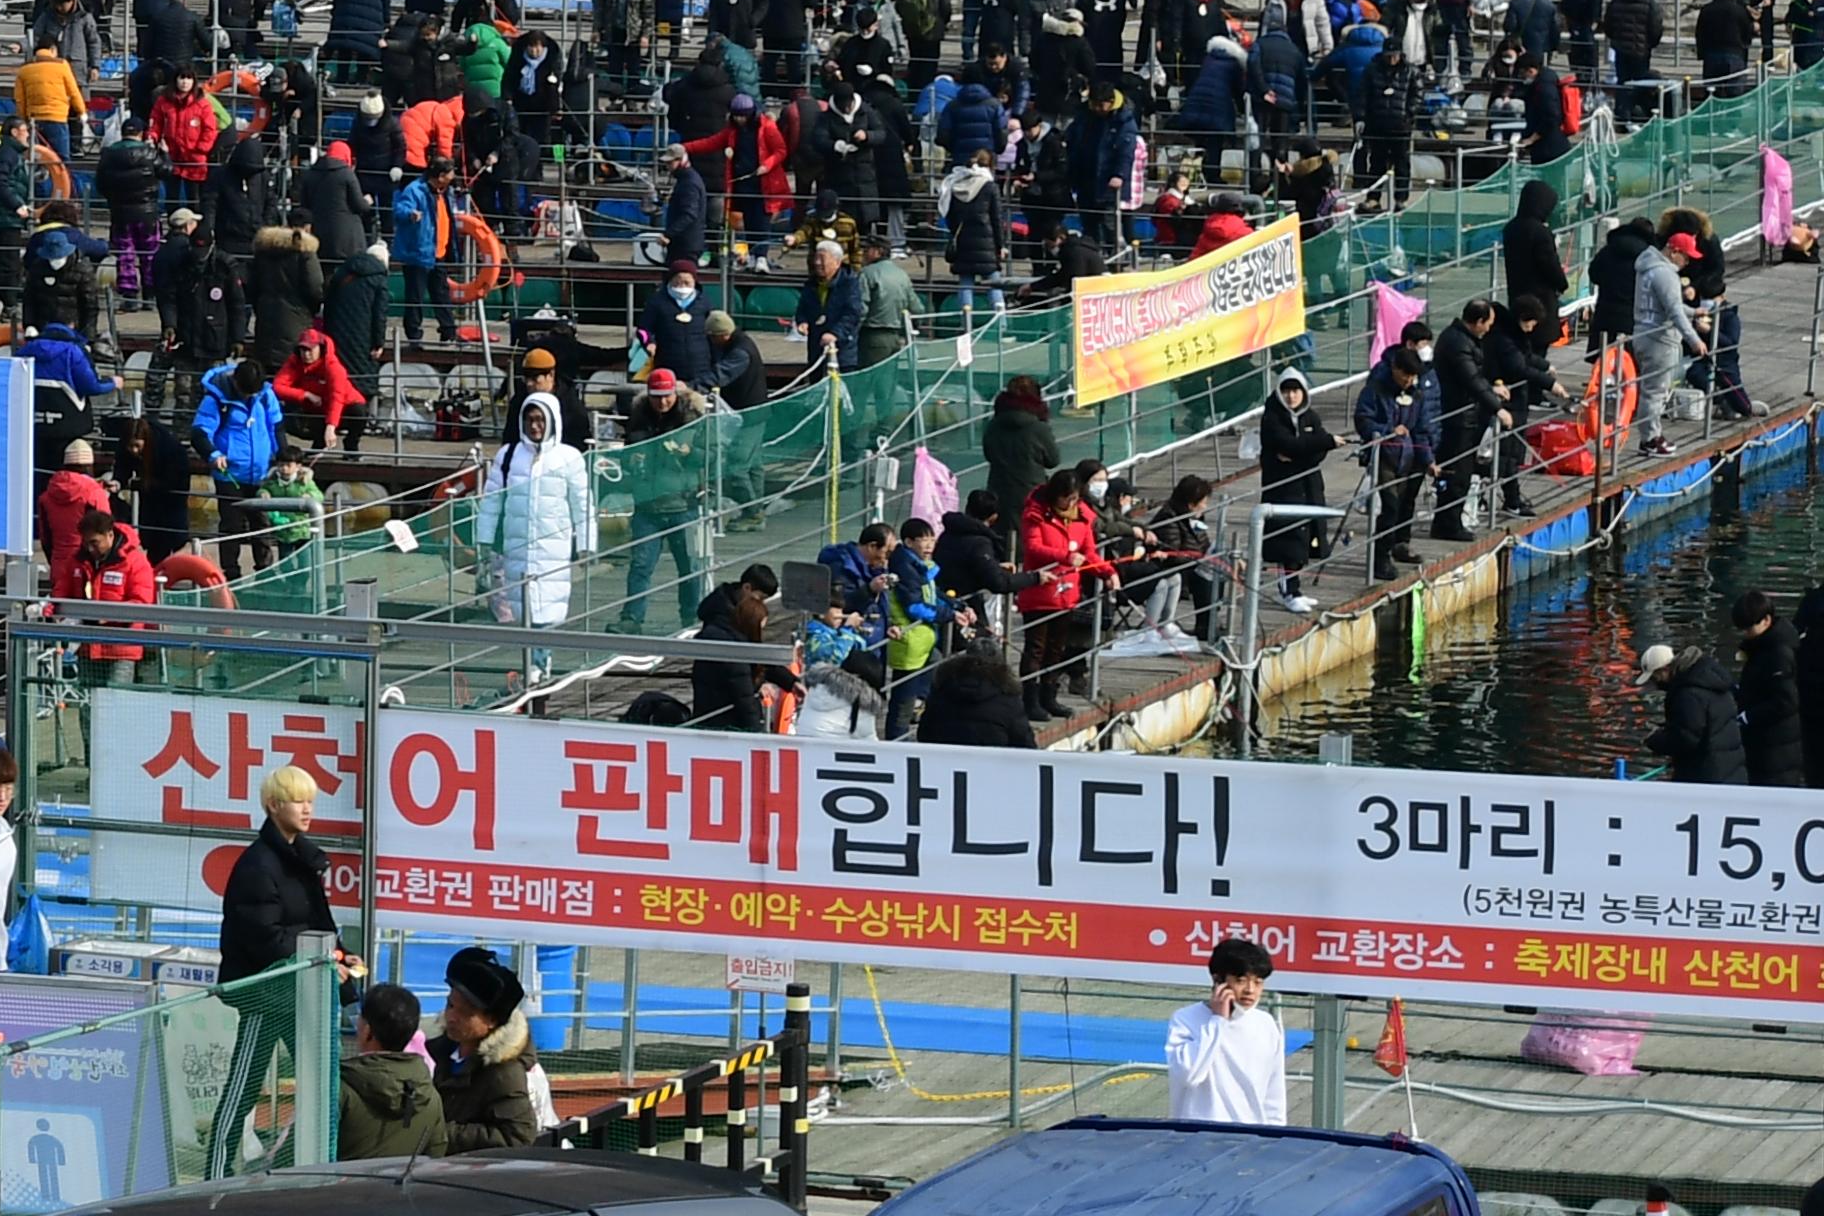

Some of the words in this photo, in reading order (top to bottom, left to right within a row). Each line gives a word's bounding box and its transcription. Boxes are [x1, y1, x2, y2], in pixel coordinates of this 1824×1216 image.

[141, 710, 499, 851] 산천어
[1356, 793, 1556, 876] 3마리
[488, 874, 595, 917] 판매점
[974, 907, 1079, 950] 접수처
[88, 958, 124, 974] 소각용
[1312, 929, 1465, 971] 교환장소
[1514, 939, 1668, 985] 축제장내
[1683, 949, 1799, 992] 산천어
